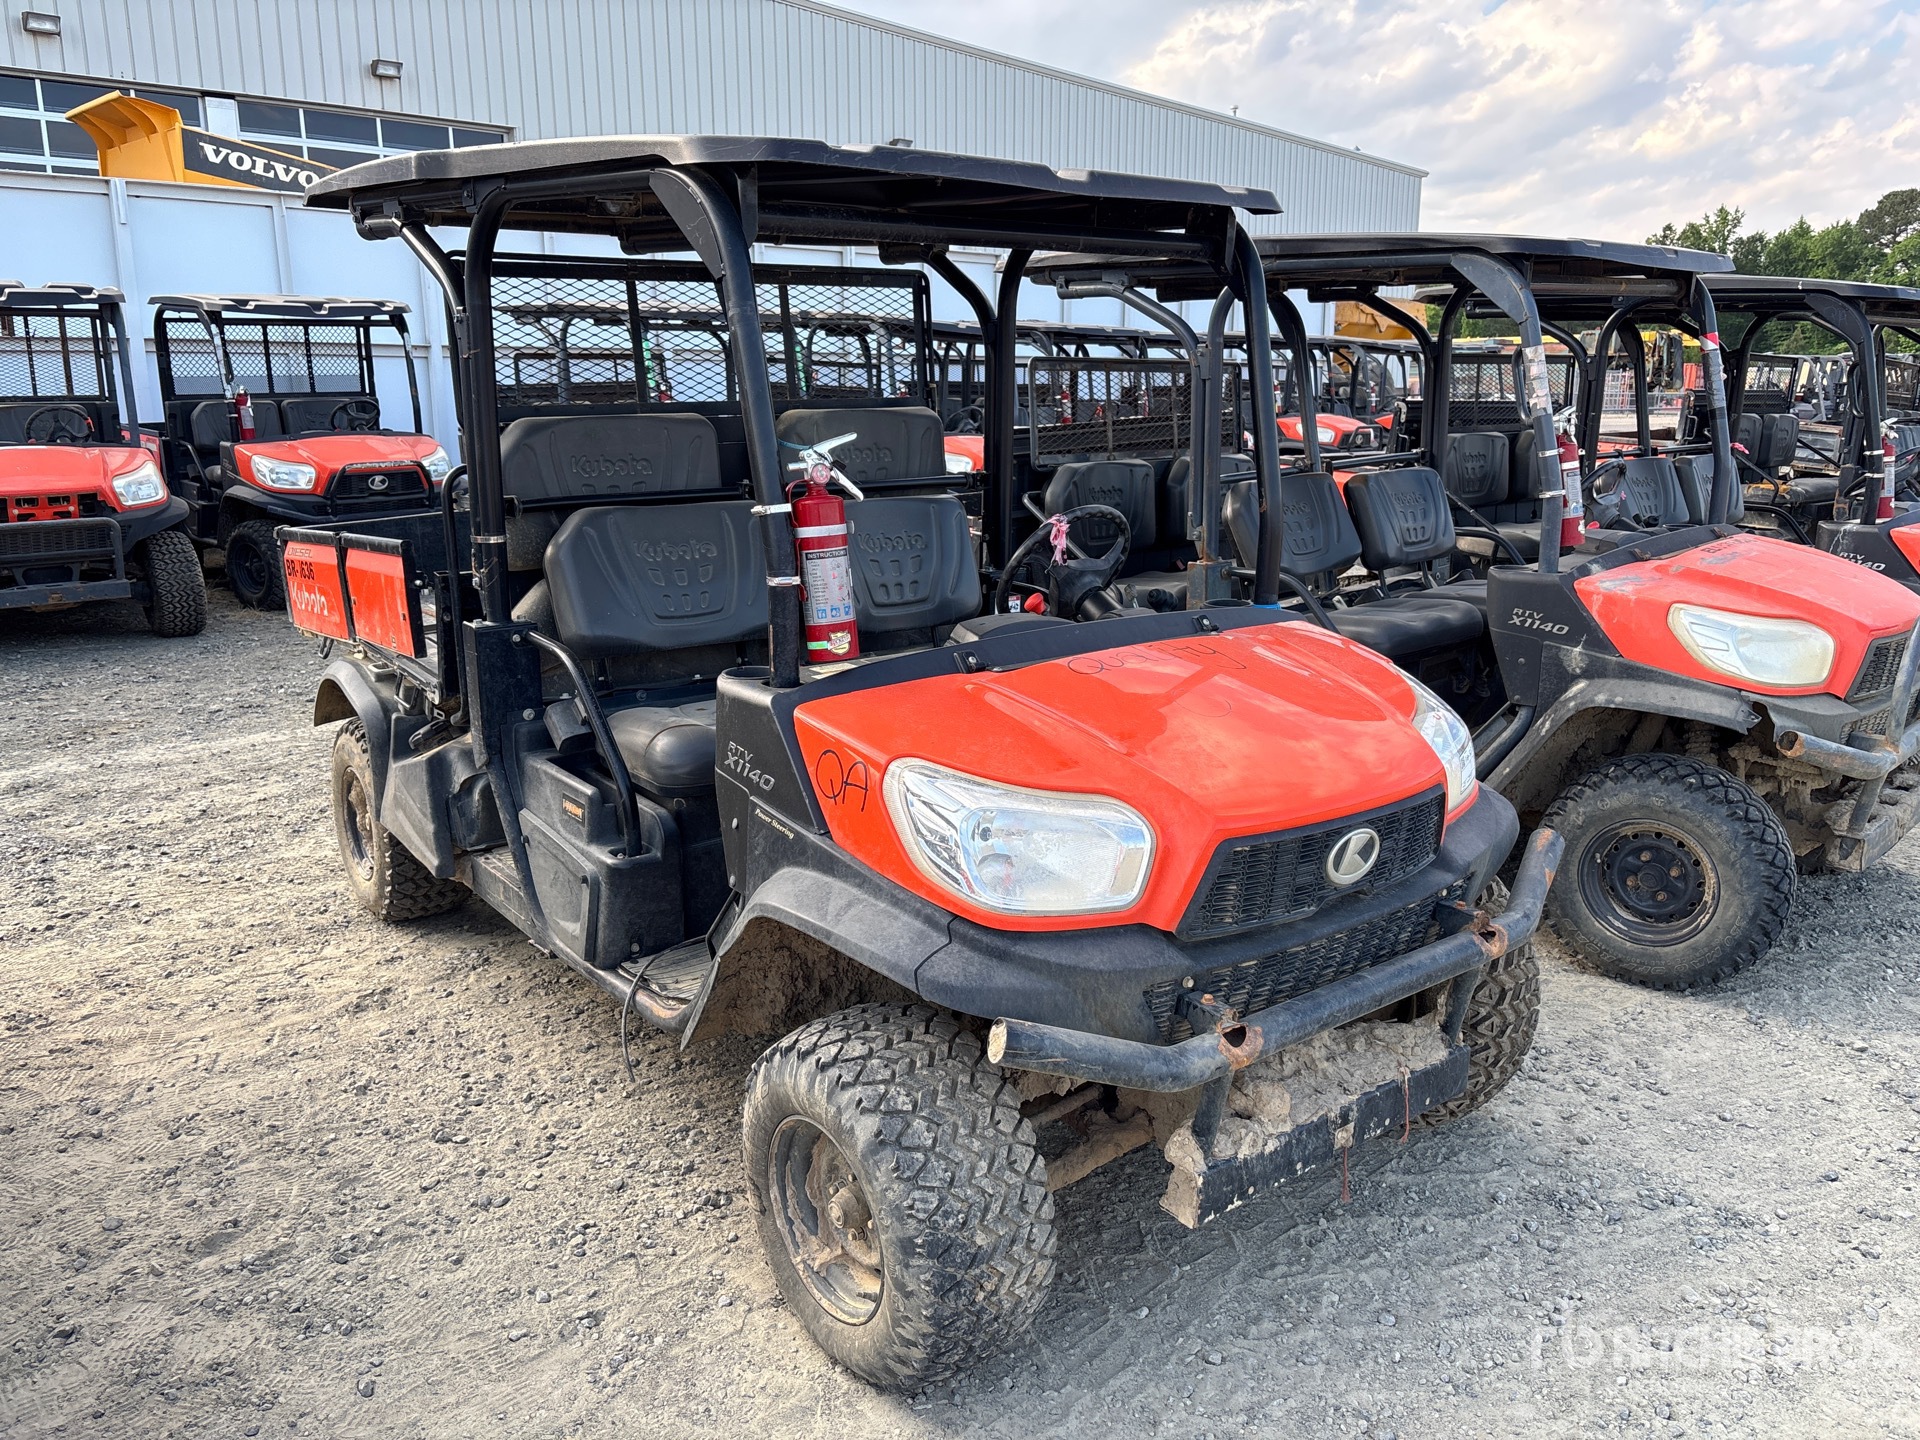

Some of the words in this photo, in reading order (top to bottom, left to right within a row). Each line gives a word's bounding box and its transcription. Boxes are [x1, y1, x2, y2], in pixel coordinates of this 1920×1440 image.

[199, 142, 320, 188] VOLVO
[571, 452, 653, 478] Kubota
[633, 538, 717, 562] Kubota
[858, 531, 927, 554] Kubota
[1839, 551, 1866, 560] RTV
[289, 581, 329, 617] Kubota
[1507, 614, 1570, 635] X1140
[1512, 607, 1544, 619] RTV
[727, 740, 754, 762] RTV
[723, 751, 776, 792] X1140
[815, 748, 869, 812] QA
[754, 808, 771, 823] Power
[771, 819, 795, 840] Steering
